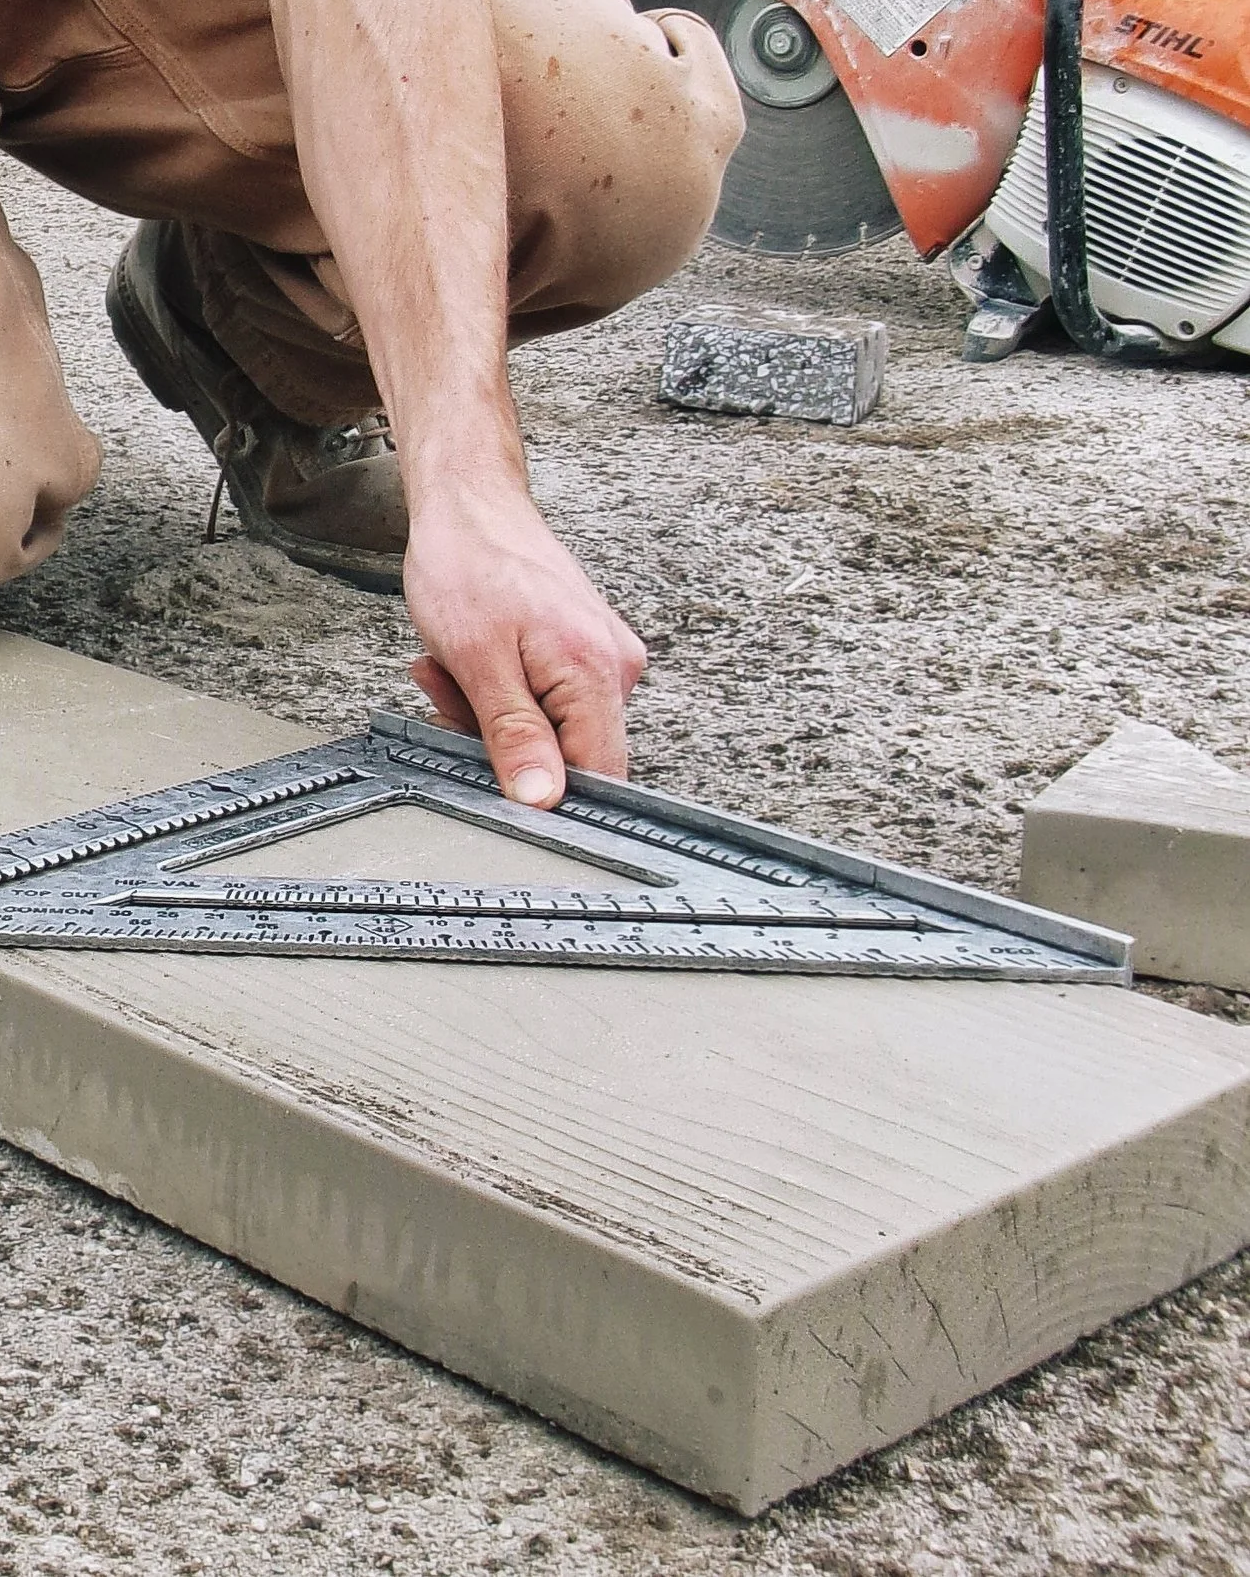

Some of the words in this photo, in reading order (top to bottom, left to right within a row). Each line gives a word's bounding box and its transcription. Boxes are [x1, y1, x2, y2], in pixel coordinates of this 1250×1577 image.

[1114, 14, 1204, 59] STIHL
[76, 821, 97, 830] 6
[130, 805, 152, 815] 5
[11, 889, 52, 898] TOP
[325, 884, 348, 892] 20
[508, 890, 532, 898] 10
[2, 906, 94, 916] COMMON
[109, 909, 133, 918] 30
[753, 930, 764, 938] 3
[825, 932, 838, 940] 2
